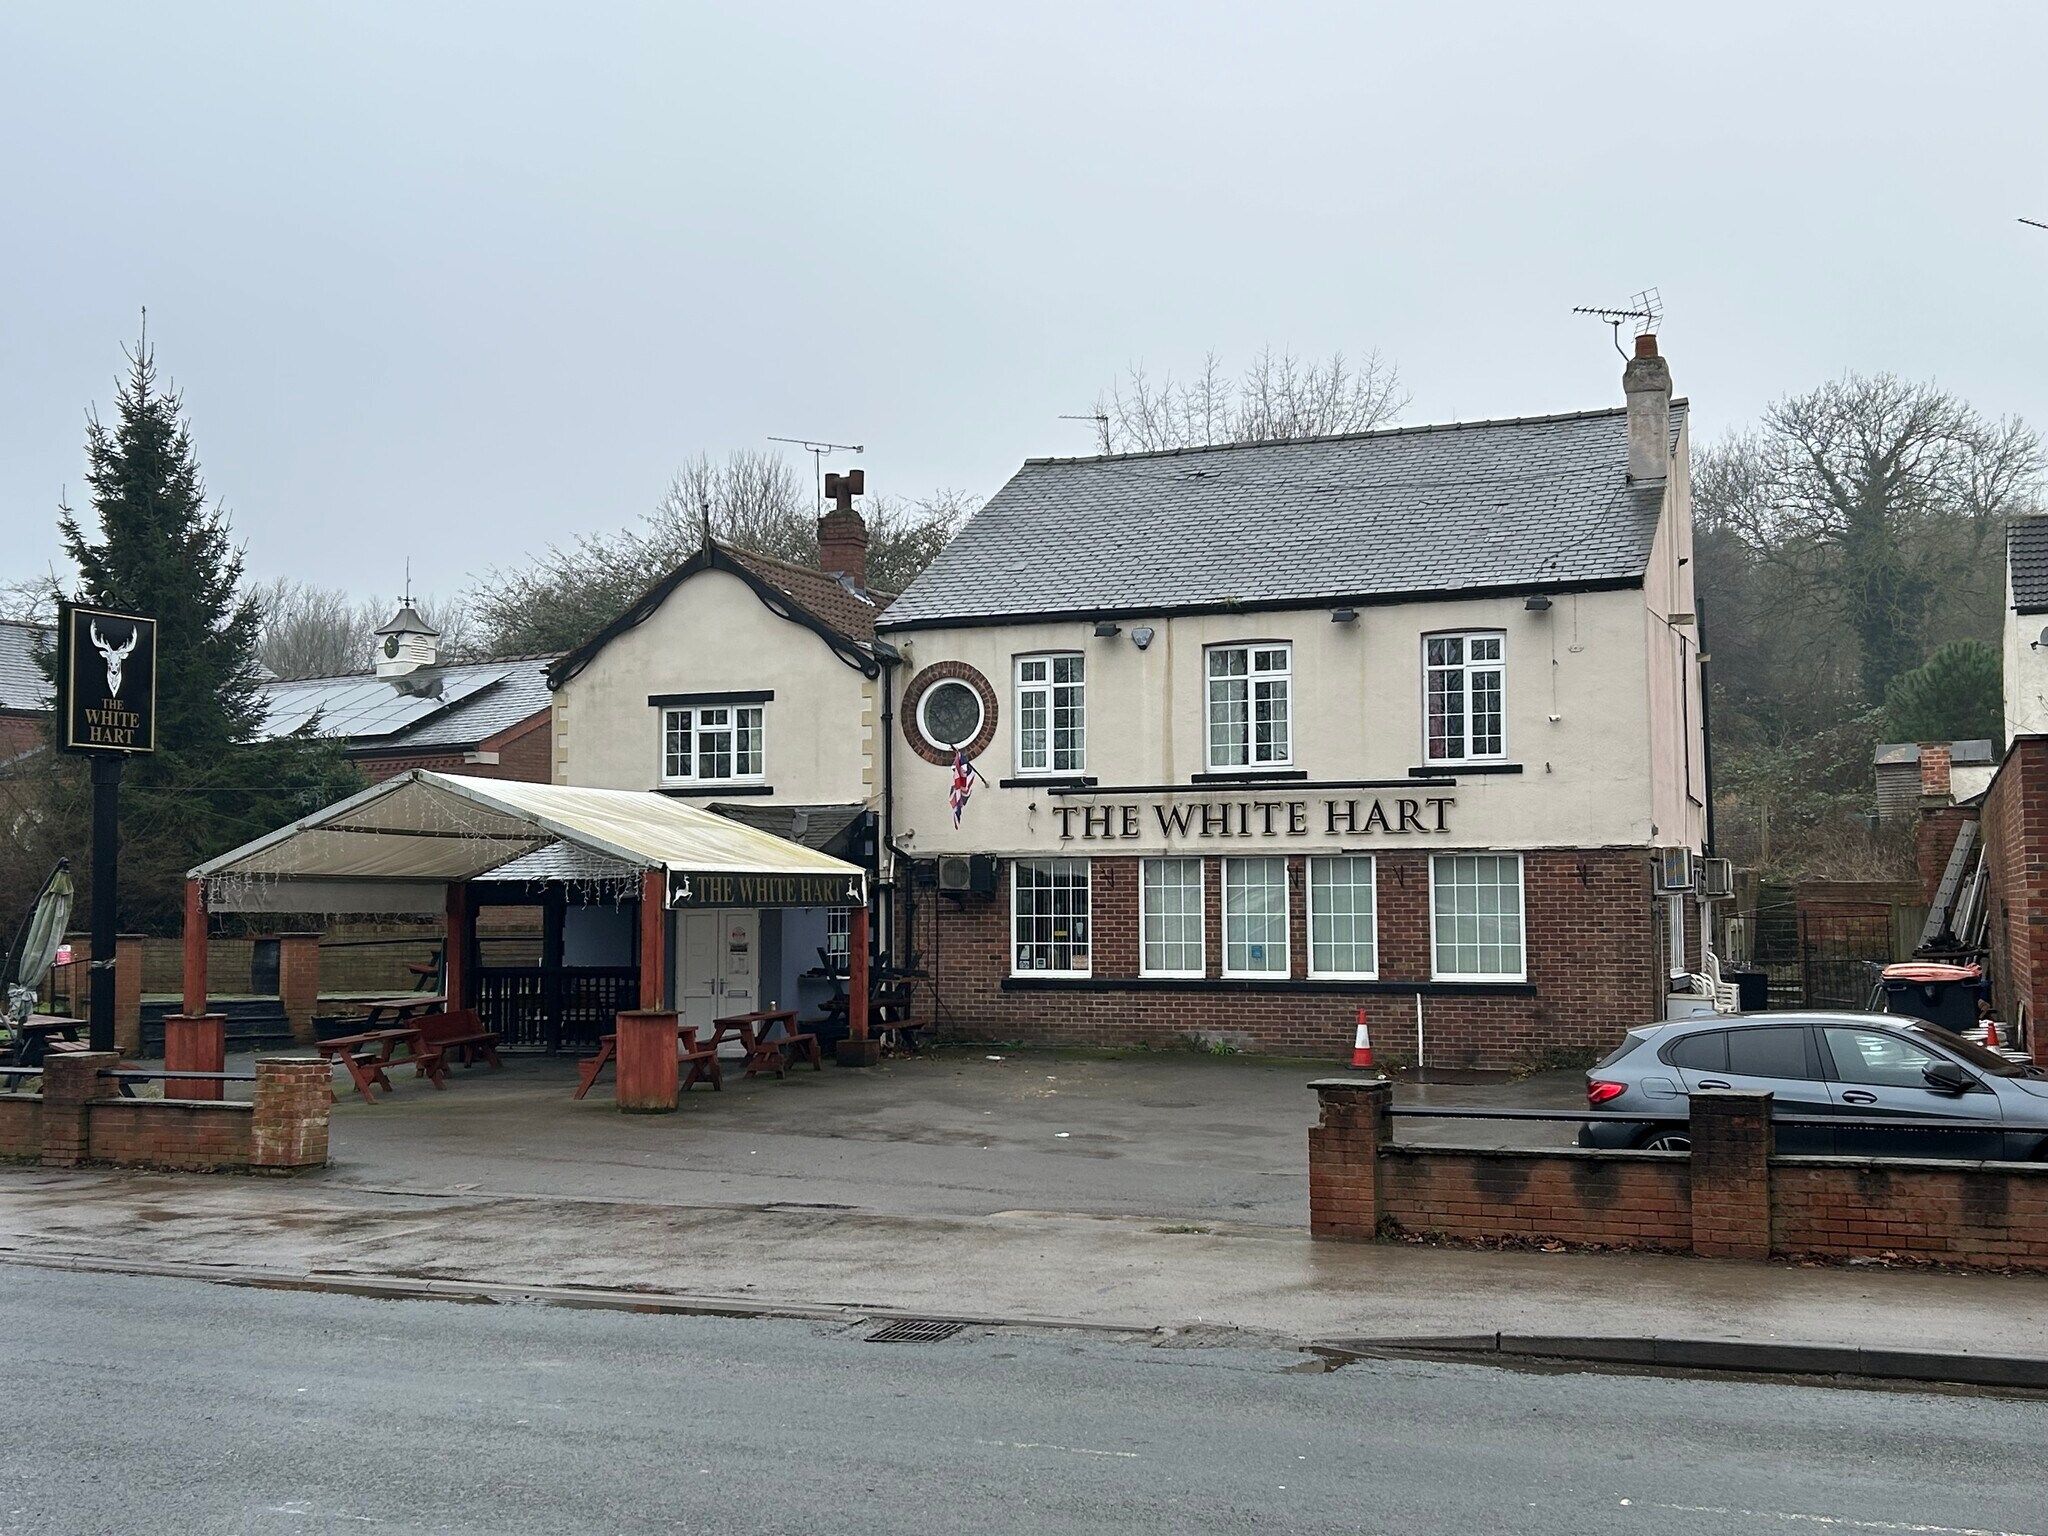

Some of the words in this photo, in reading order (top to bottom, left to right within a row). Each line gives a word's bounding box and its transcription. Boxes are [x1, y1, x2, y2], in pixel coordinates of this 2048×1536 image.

[101, 698, 124, 710] THE
[85, 708, 140, 728] WHITE
[89, 726, 135, 744] HART
[1052, 804, 1140, 840] THE
[1152, 801, 1308, 839] WHITE
[1323, 797, 1456, 836] HART
[697, 876, 735, 903] THE
[739, 876, 798, 903] WHITE
[801, 877, 843, 903] HART
